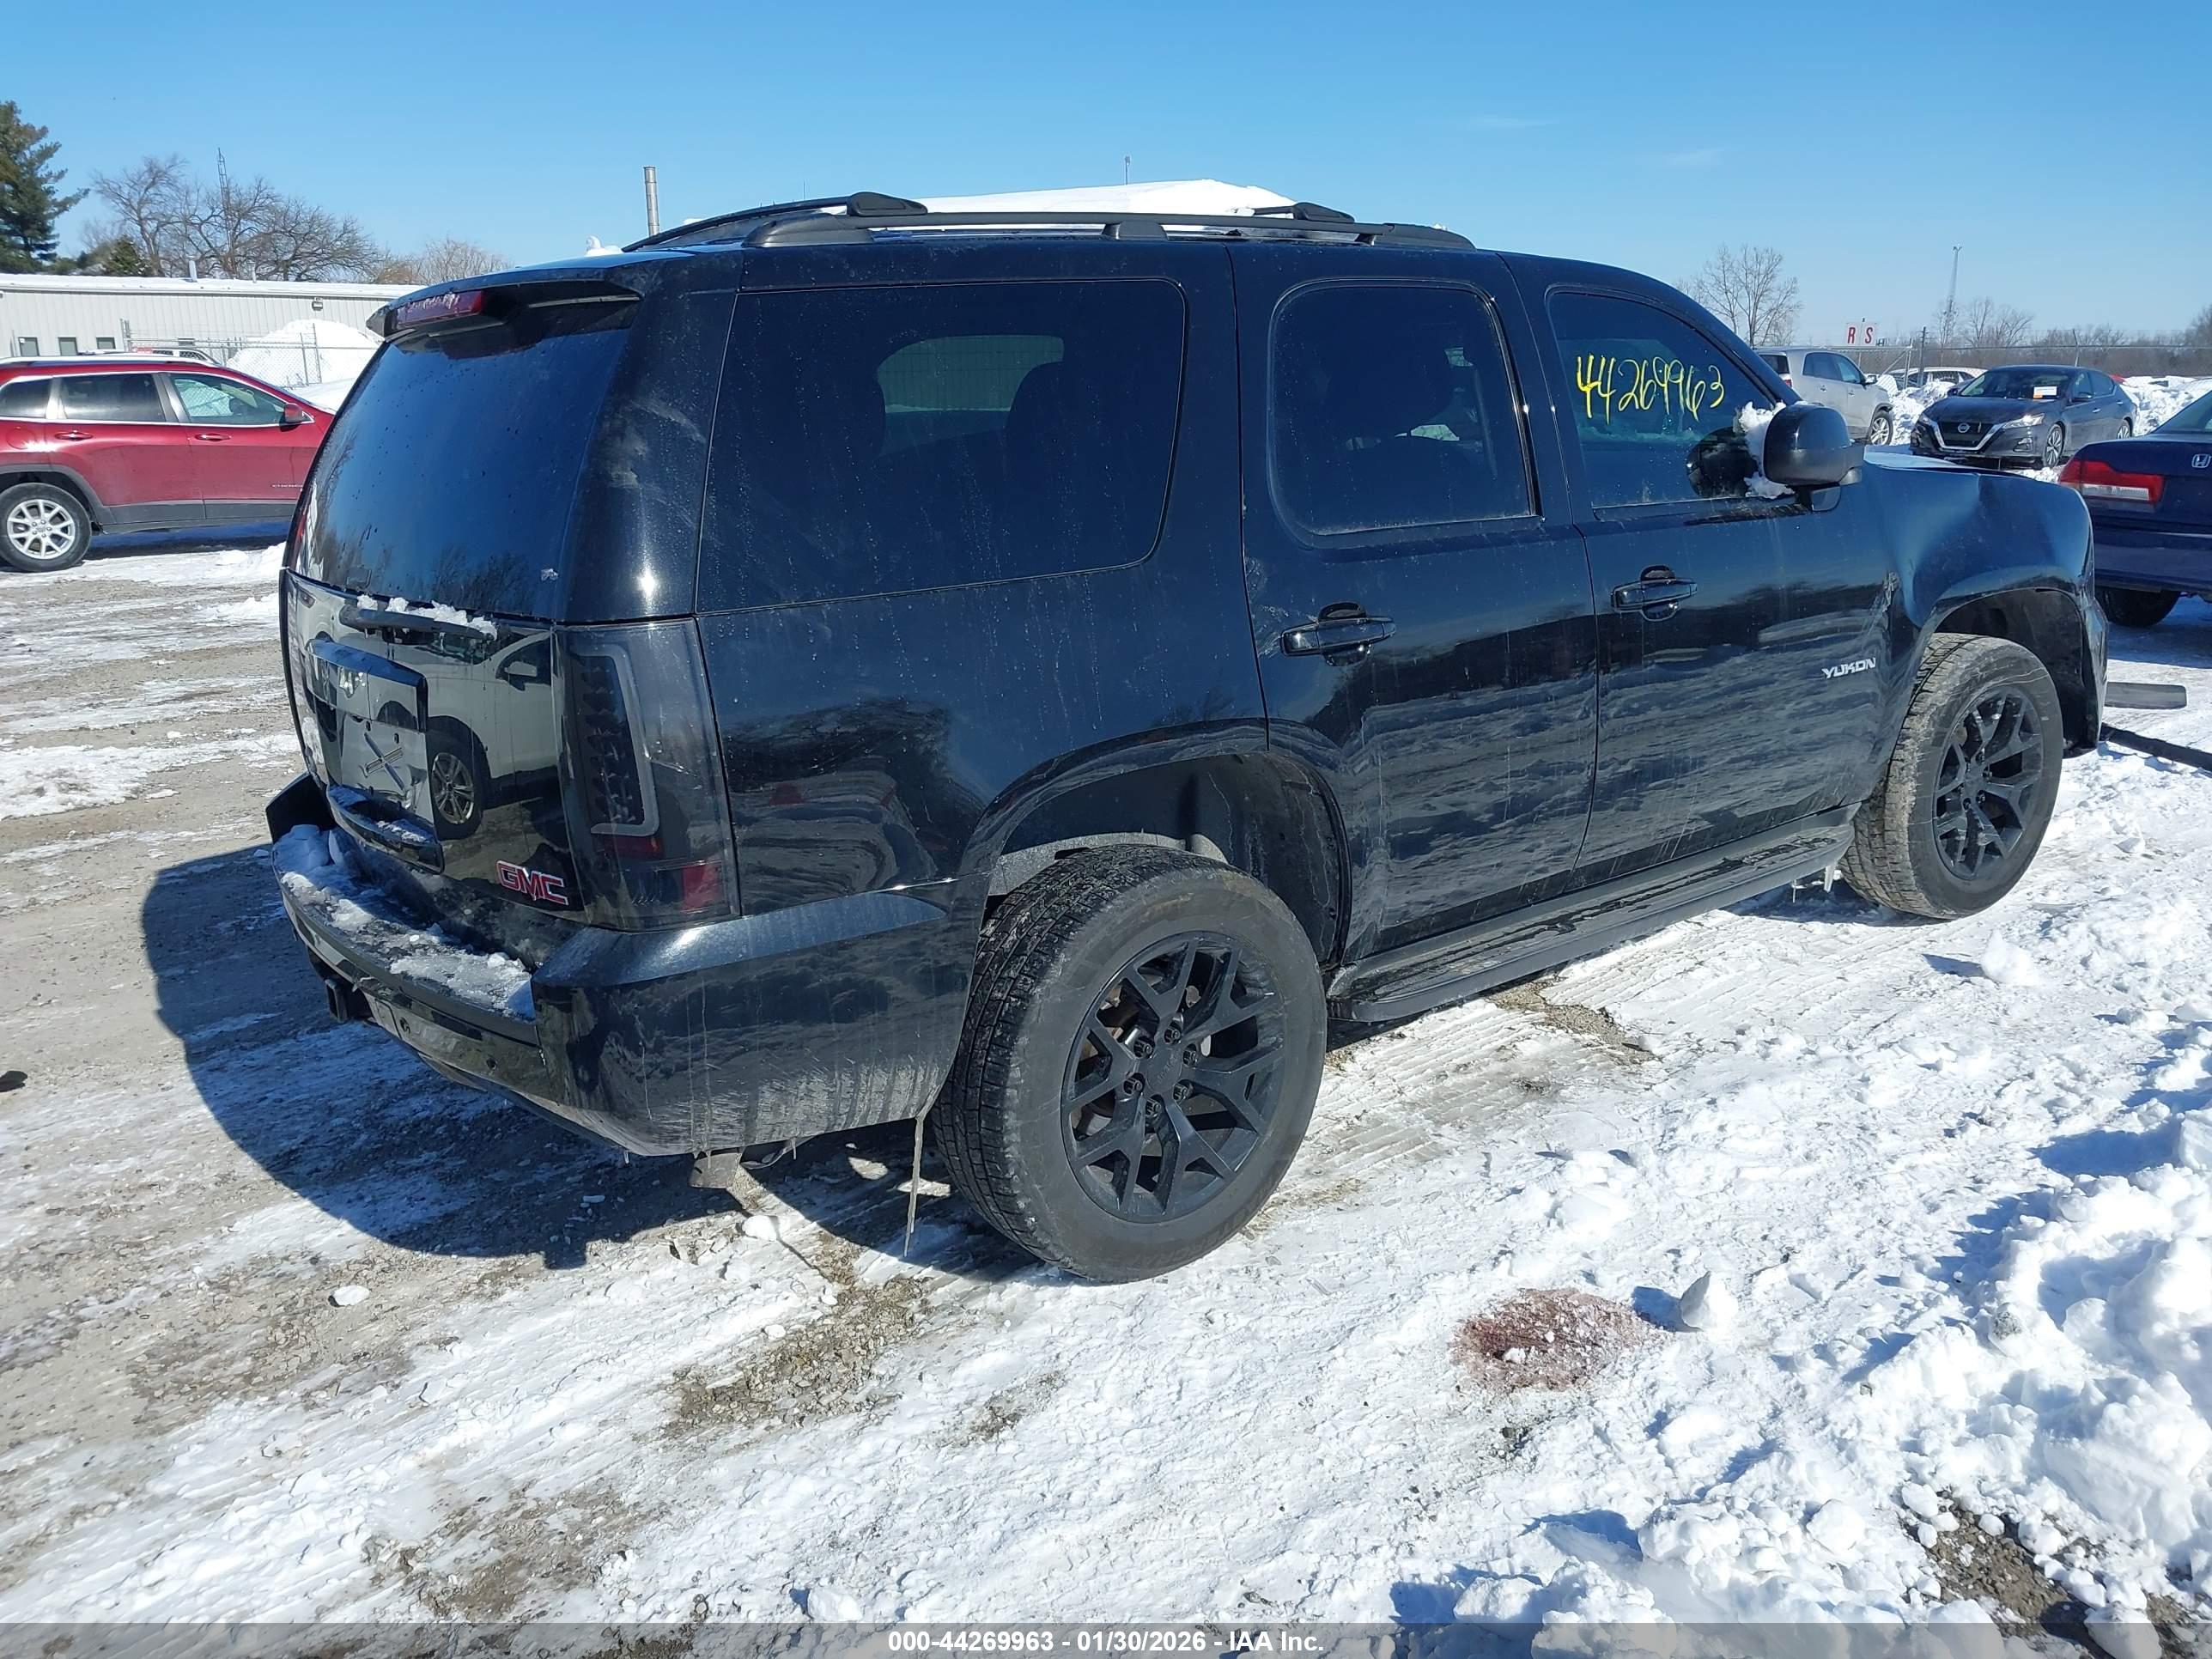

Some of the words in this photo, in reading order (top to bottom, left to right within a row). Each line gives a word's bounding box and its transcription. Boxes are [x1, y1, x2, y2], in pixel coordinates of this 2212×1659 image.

[1847, 326, 1856, 344] R
[1864, 326, 1874, 344] S
[1577, 353, 1725, 425] 44269963
[1821, 657, 1876, 679] YUKON
[496, 860, 569, 906] GMC
